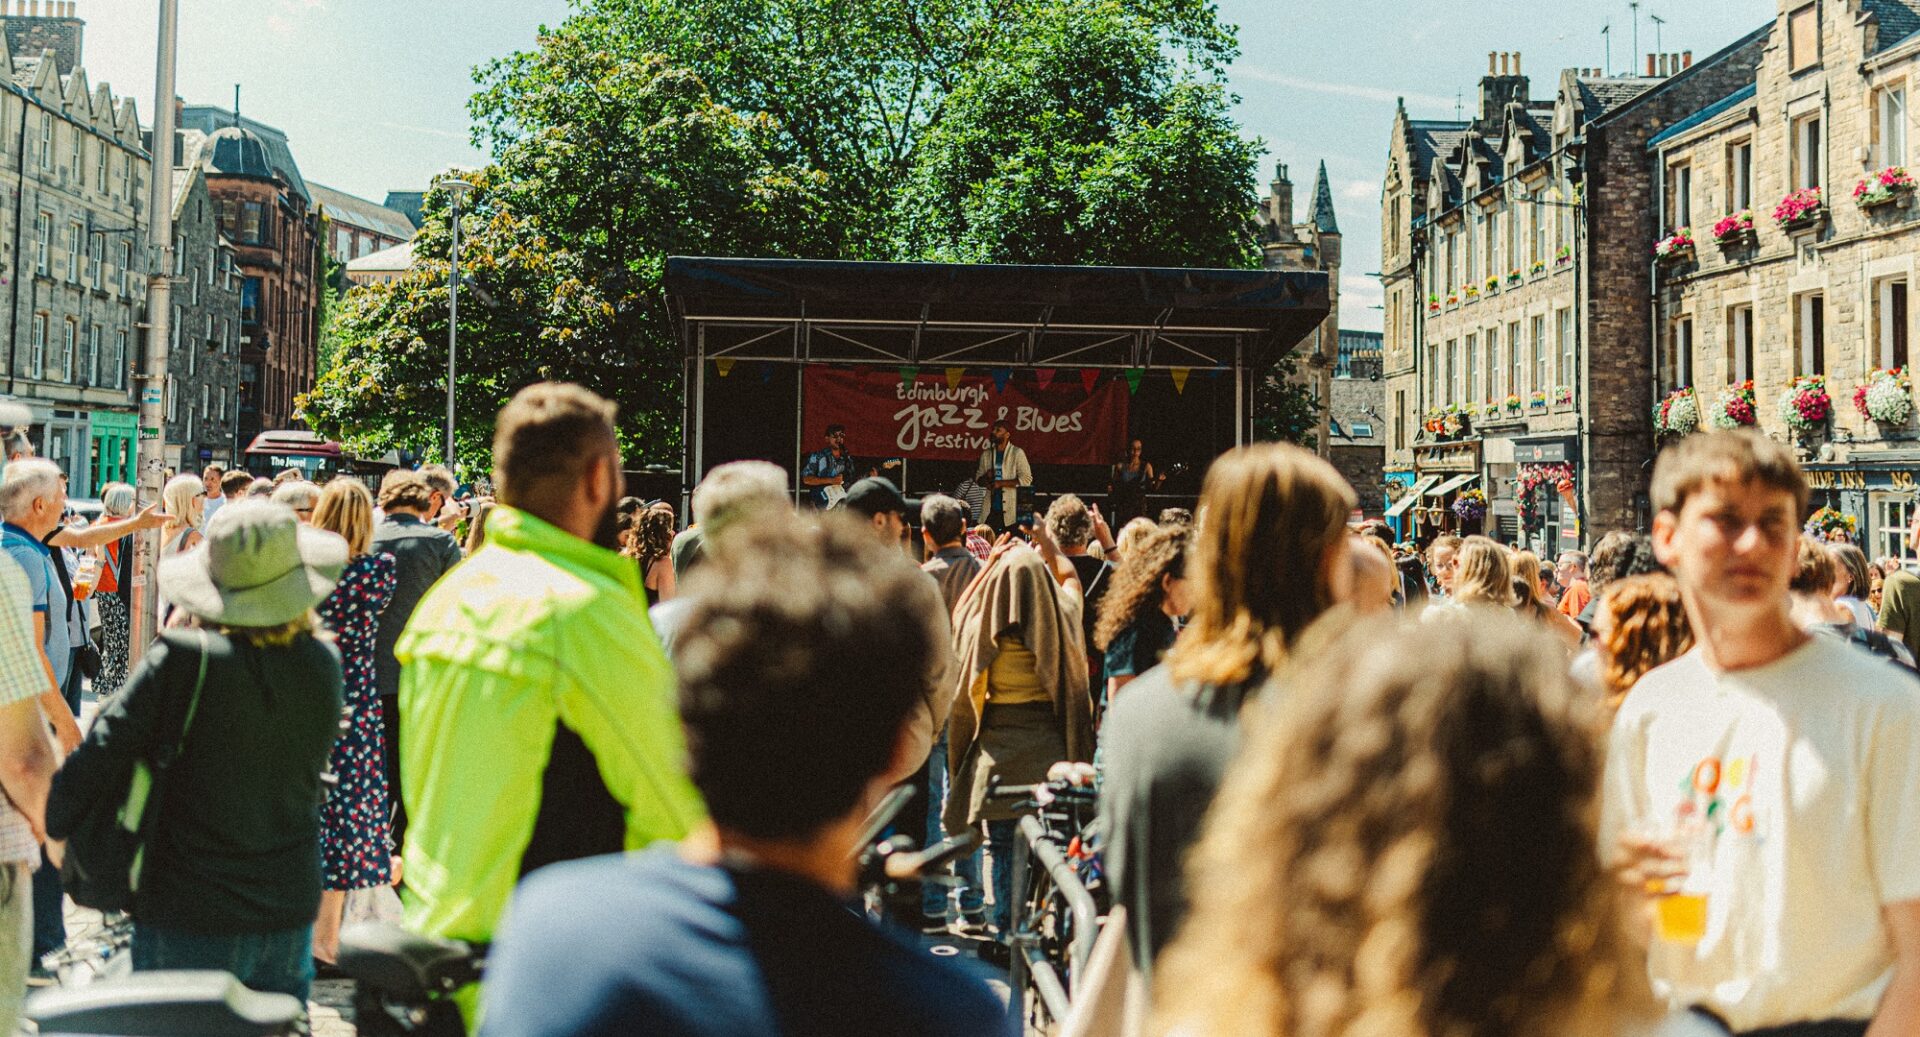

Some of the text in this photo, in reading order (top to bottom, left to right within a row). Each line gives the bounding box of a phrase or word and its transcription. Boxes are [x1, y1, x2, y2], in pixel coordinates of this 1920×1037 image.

[896, 381, 989, 407] Edinburgh
[893, 403, 989, 451] Jazz
[1015, 406, 1083, 433] Blues
[923, 431, 997, 449] Festiva
[270, 456, 326, 470] The Jewel 2
[1840, 471, 1865, 490] INN
